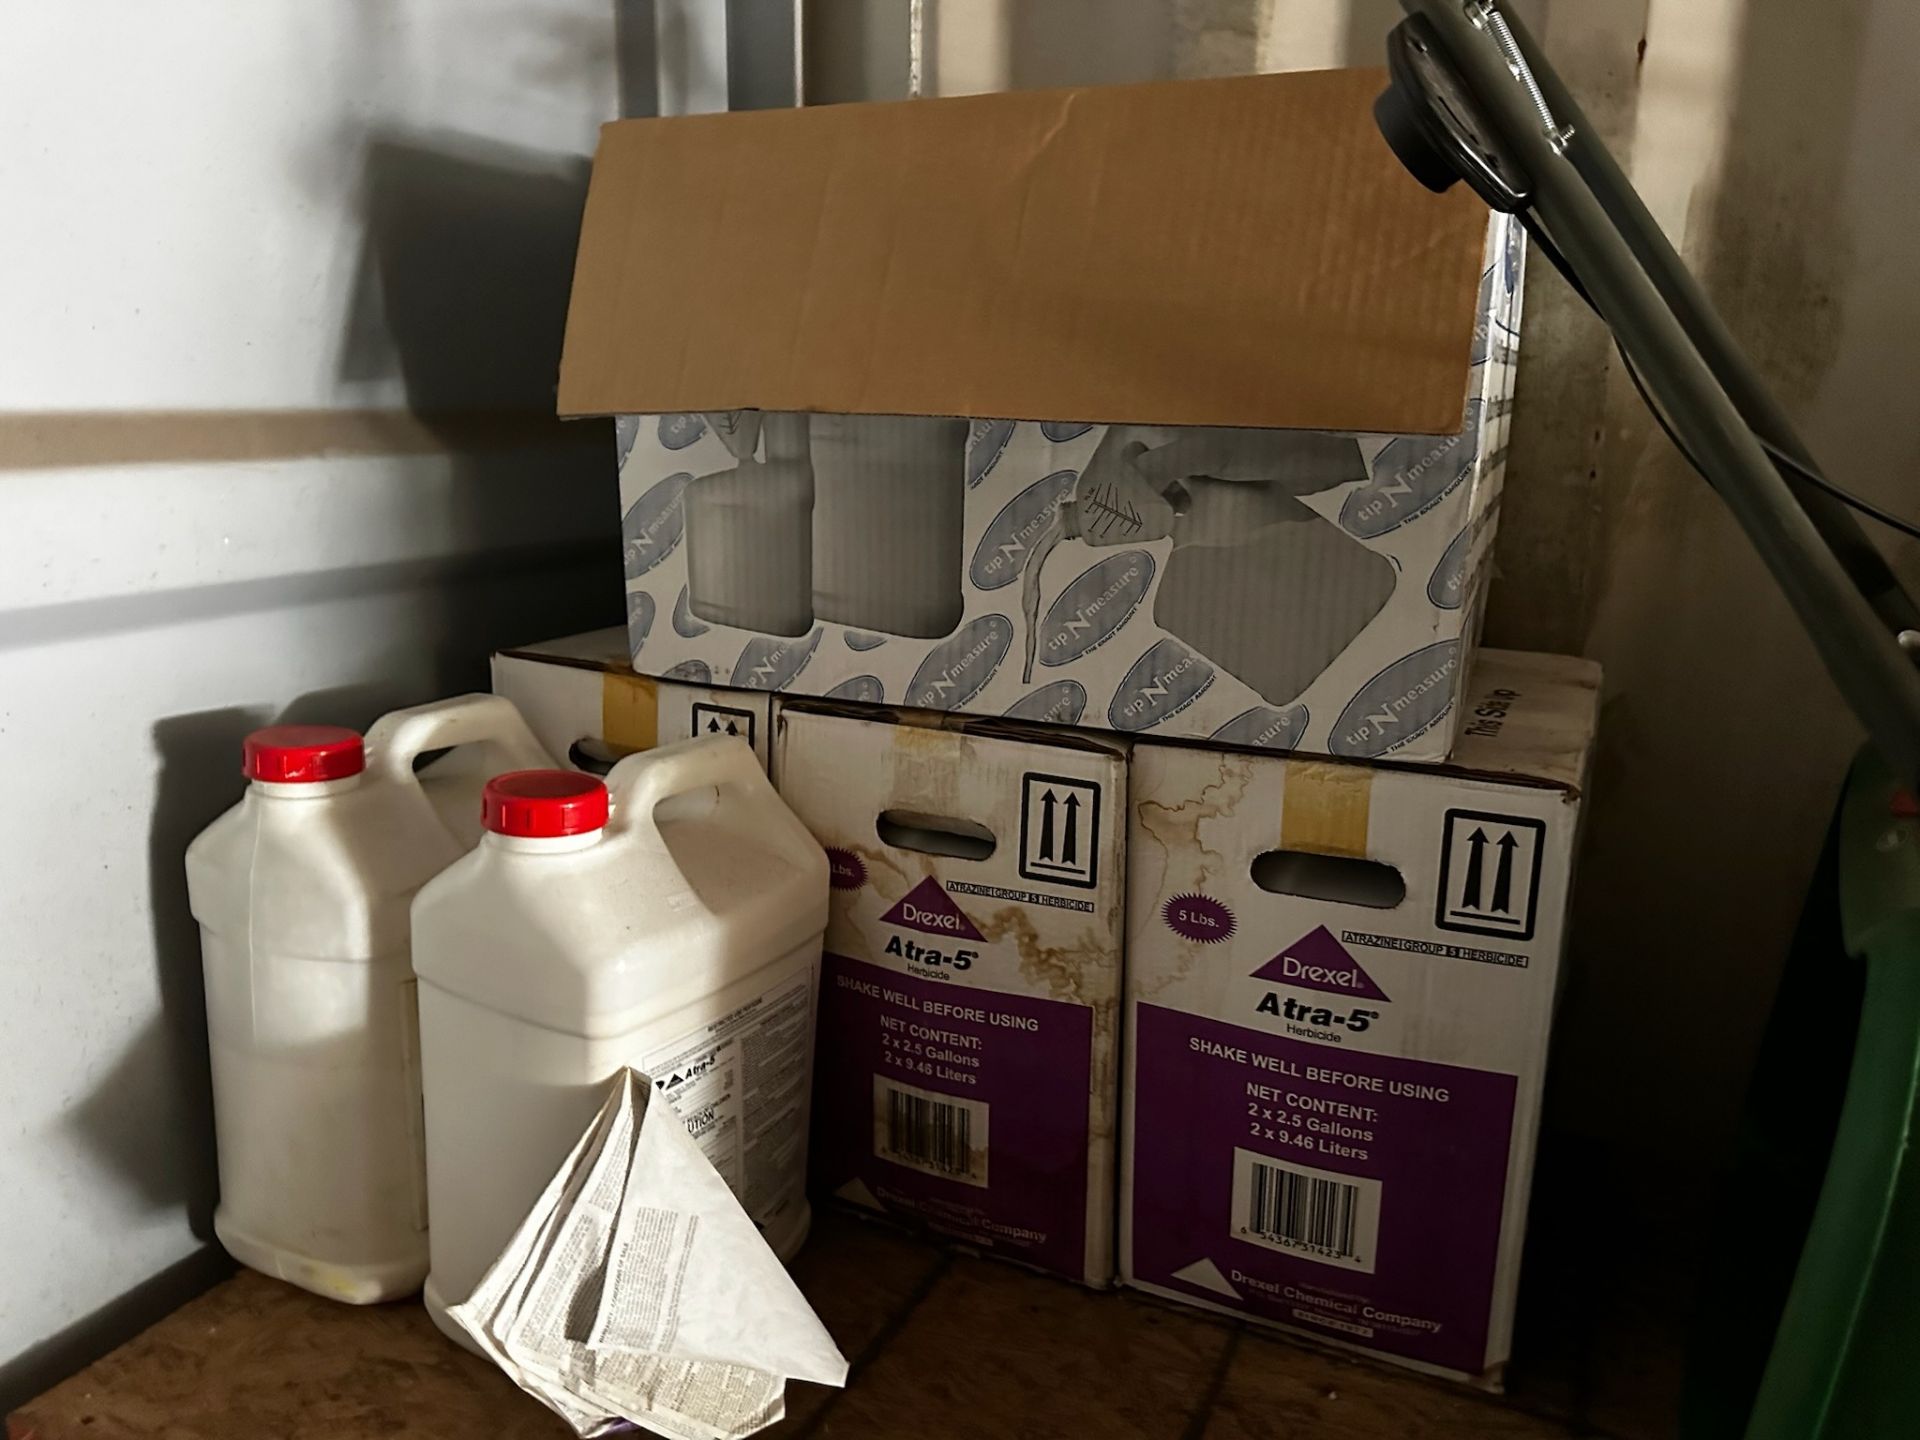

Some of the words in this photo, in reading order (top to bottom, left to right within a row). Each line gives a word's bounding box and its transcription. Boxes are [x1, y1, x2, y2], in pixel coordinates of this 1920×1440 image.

[1358, 499, 1384, 521] tip
[1379, 473, 1413, 508] N
[984, 556, 1003, 575] tip
[1000, 534, 1026, 563] N
[1048, 632, 1068, 650] tip
[1063, 609, 1091, 641] N
[1085, 567, 1140, 617] measure
[930, 668, 957, 699] N
[949, 630, 1000, 679] measure
[1123, 698, 1145, 717] tip
[1140, 676, 1168, 706] N
[1195, 675, 1217, 701] AMOUNT
[1345, 726, 1371, 746] tip
[1364, 703, 1399, 735] N
[1392, 659, 1458, 712] measure
[949, 881, 993, 899] ATRAZINE
[996, 888, 1027, 902] GROUP
[1041, 894, 1092, 911] HERBICIDE
[902, 903, 960, 931] Drexel
[1178, 909, 1188, 921] 5
[1190, 911, 1220, 928] Lbs.
[1345, 934, 1399, 956] ATRAZINE
[1403, 943, 1445, 962] GROUP
[1448, 947, 1459, 959] 5
[1462, 949, 1525, 969] HERBICIDE
[906, 963, 950, 981] Herbicide
[1282, 956, 1360, 989] Drexel
[836, 974, 881, 999] SHAKE
[883, 988, 920, 1011] WELL
[923, 1000, 986, 1024] BEFORE
[989, 1012, 1039, 1032] USING
[880, 1014, 906, 1033] NET
[909, 1023, 983, 1050] CONTENT:
[881, 1032, 891, 1046] 2
[893, 1039, 902, 1049] x
[904, 1040, 922, 1056] 2.5
[925, 1046, 981, 1068] Gallons
[1286, 1022, 1343, 1044] Herbicide
[884, 1050, 893, 1064] 2
[895, 1057, 903, 1067] x
[906, 1058, 934, 1077] 9.46
[936, 1065, 977, 1085] Liters
[1189, 1037, 1248, 1064] SHAKE
[1252, 1053, 1302, 1078] WELL
[1306, 1066, 1384, 1093] BEFORE
[1389, 1081, 1450, 1103] USING
[686, 1105, 716, 1135] UTION
[1246, 1082, 1284, 1102] NET
[1286, 1092, 1380, 1123] CONTENT:
[1247, 1103, 1259, 1117] 2
[1262, 1109, 1272, 1121] x
[1277, 1110, 1302, 1128] 2.5
[1306, 1116, 1374, 1142] Gallons
[1250, 1122, 1261, 1137] 2
[1265, 1129, 1275, 1141] x
[1279, 1131, 1315, 1151] 9.46
[1319, 1142, 1369, 1161] Liters
[1230, 1269, 1280, 1295] Drexel
[1283, 1284, 1358, 1316] Chemical
[1362, 1306, 1443, 1334] Company
